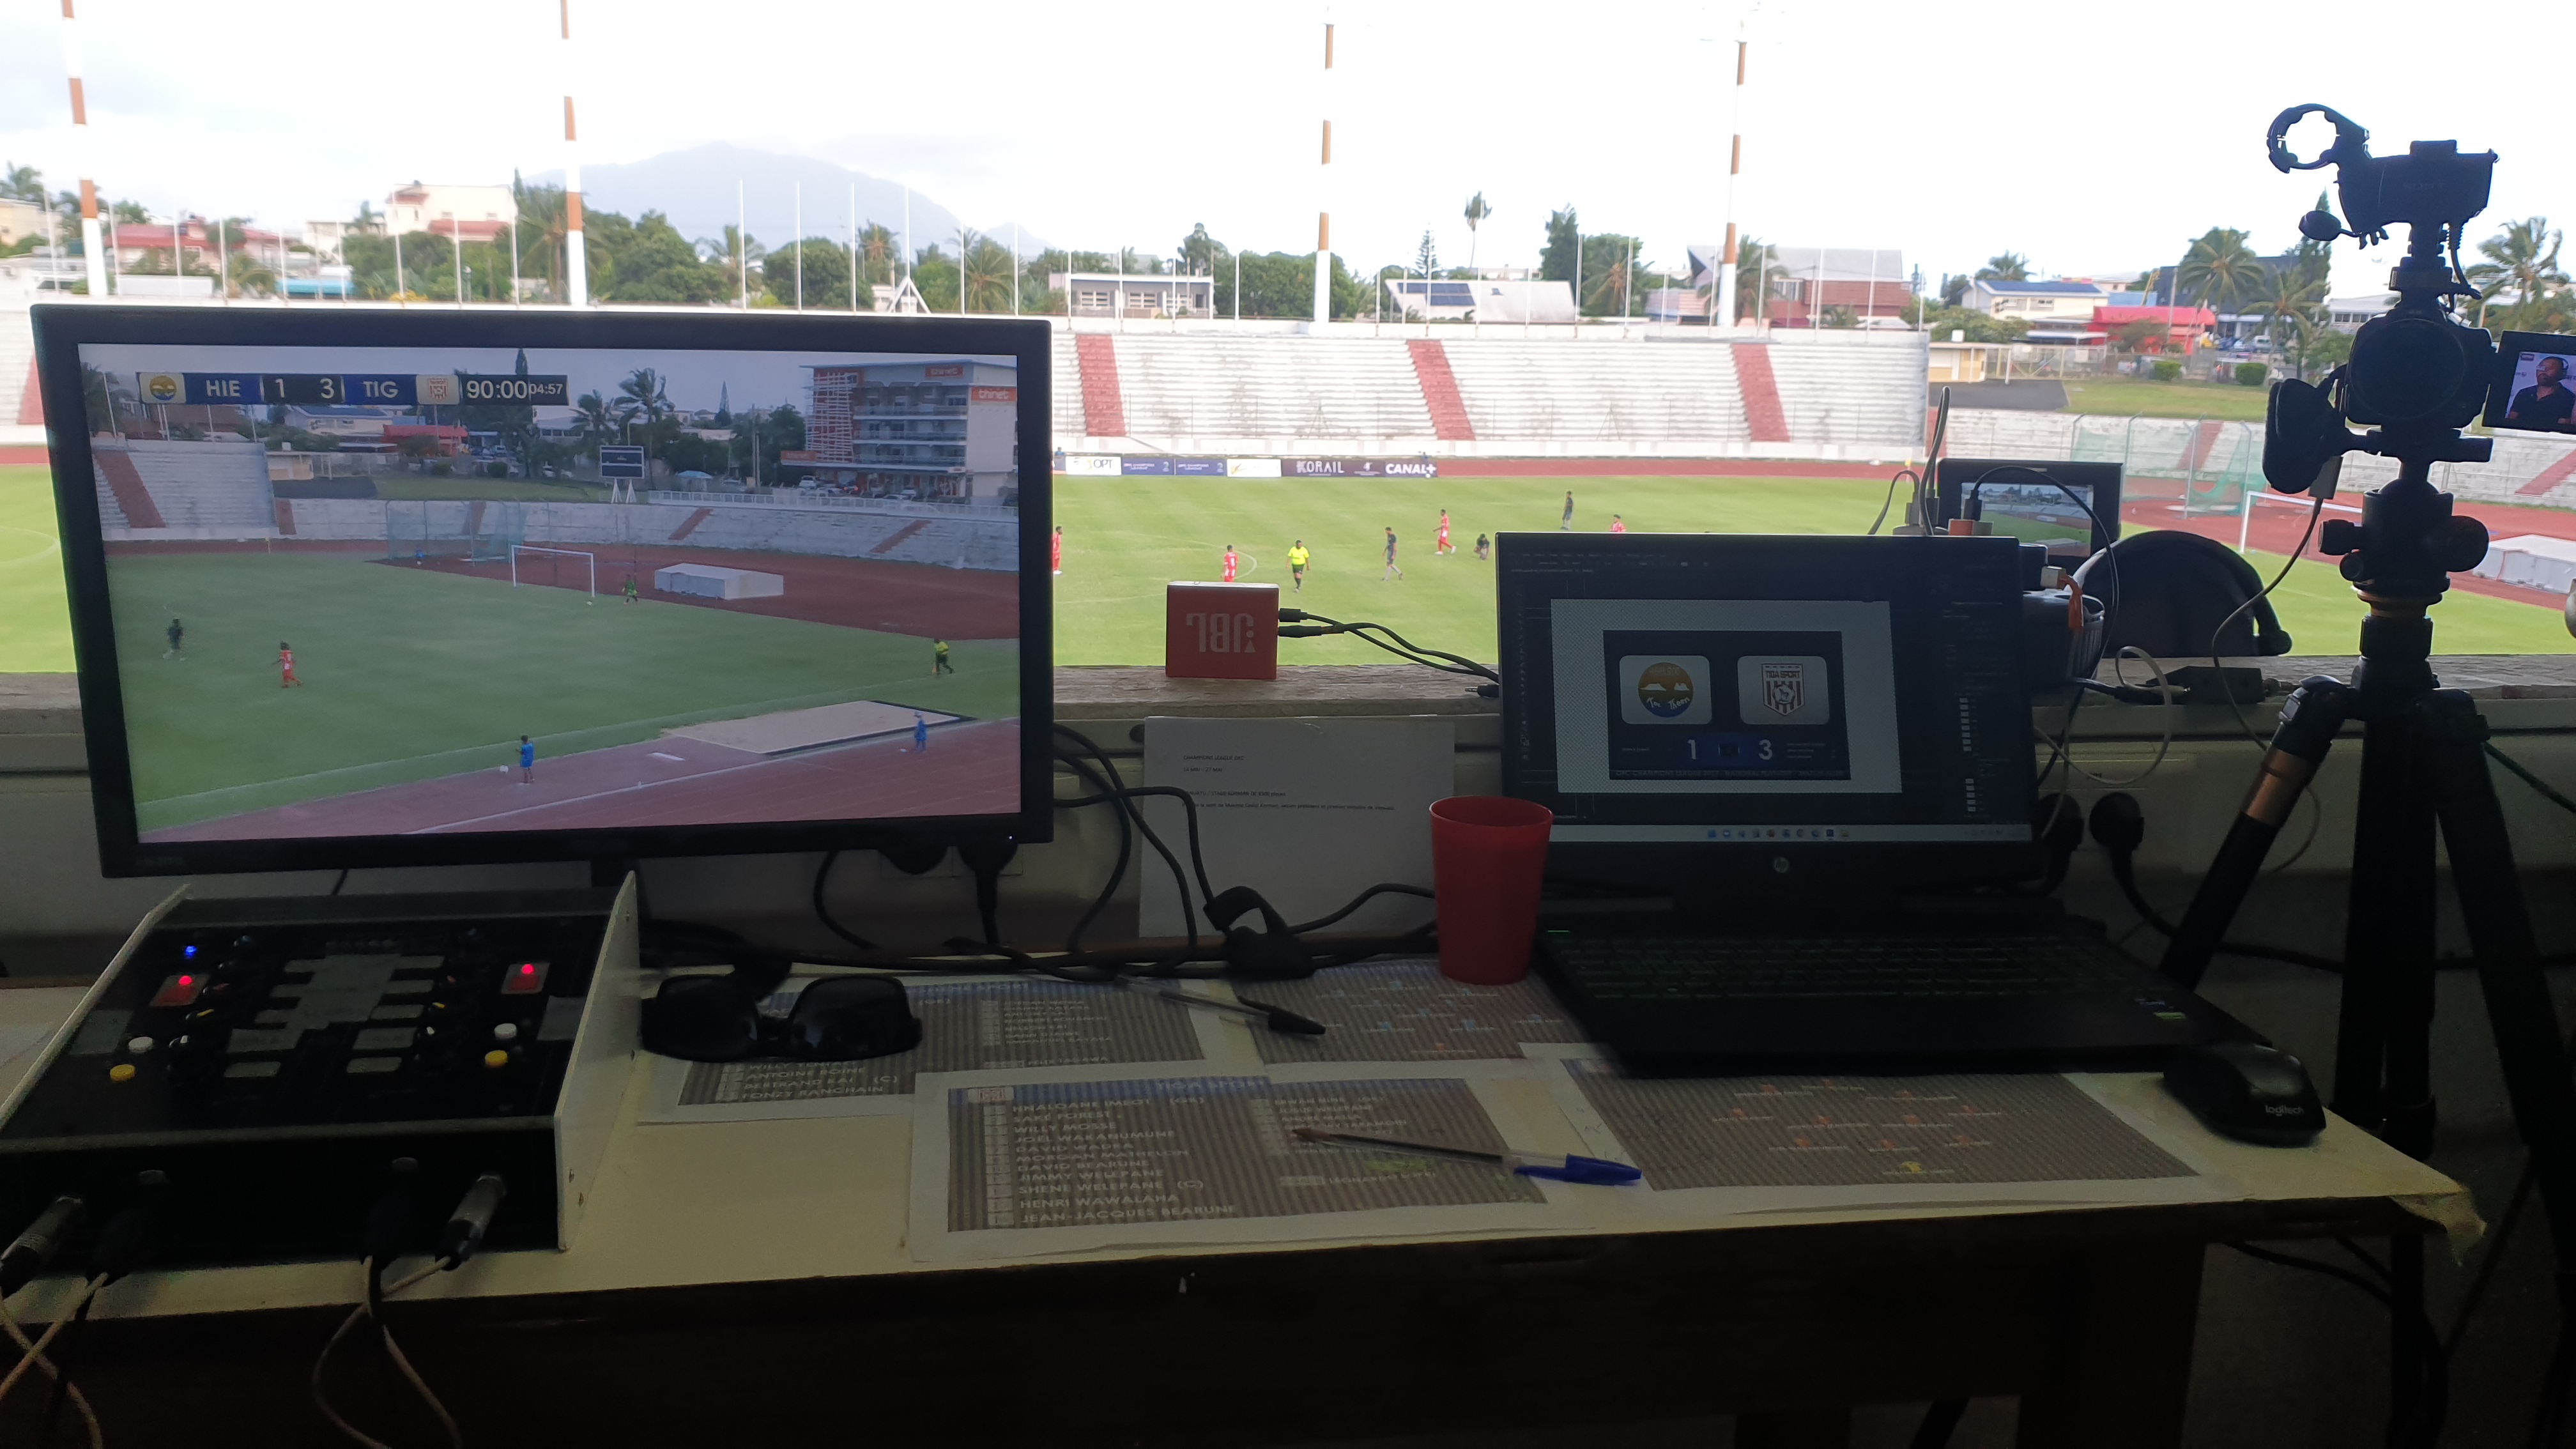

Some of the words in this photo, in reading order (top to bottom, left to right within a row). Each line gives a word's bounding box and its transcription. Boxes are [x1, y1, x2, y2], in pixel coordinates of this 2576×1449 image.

[205, 379, 241, 397] HIE
[274, 379, 286, 398] 1
[320, 379, 335, 399] 3
[364, 380, 399, 399] TIG
[466, 379, 528, 399] 90:00
[530, 382, 564, 395] 04:57
[1093, 458, 1113, 469] OPT
[1296, 460, 1345, 474] KORAIL
[1384, 463, 1437, 475] CANAL+
[1186, 613, 1255, 653] JBL
[1780, 670, 1800, 678] SPORT
[1687, 739, 1698, 760] 1
[1758, 739, 1774, 760] 3
[2264, 1104, 2304, 1117] logitech
[1020, 1198, 1070, 1209] HENRI
[1020, 1209, 1156, 1223] JEAN-JACQUES
